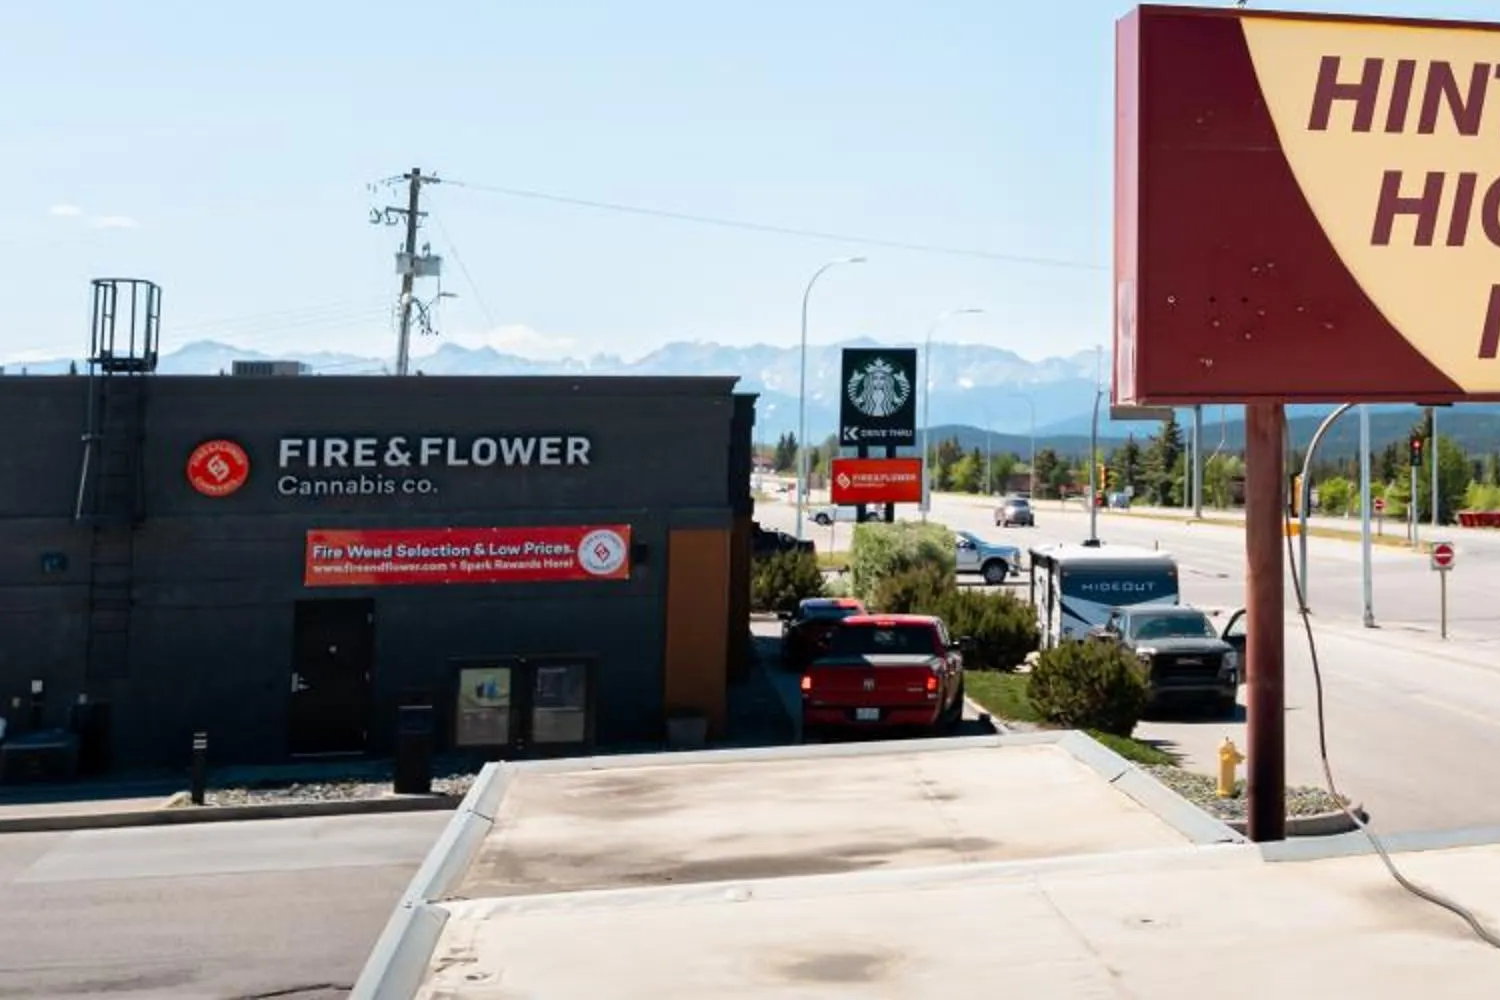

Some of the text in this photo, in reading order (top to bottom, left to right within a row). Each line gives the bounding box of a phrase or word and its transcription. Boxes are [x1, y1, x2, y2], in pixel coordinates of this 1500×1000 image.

[277, 474, 438, 495] Cannabis co.
[313, 544, 343, 559] Fire
[347, 543, 393, 558] Weed
[397, 543, 471, 558] Selection
[473, 542, 485, 556] &
[489, 542, 521, 556] Low
[459, 559, 492, 574] Spark
[494, 559, 541, 570] Rewards
[1081, 581, 1156, 592] HIDEOUT
